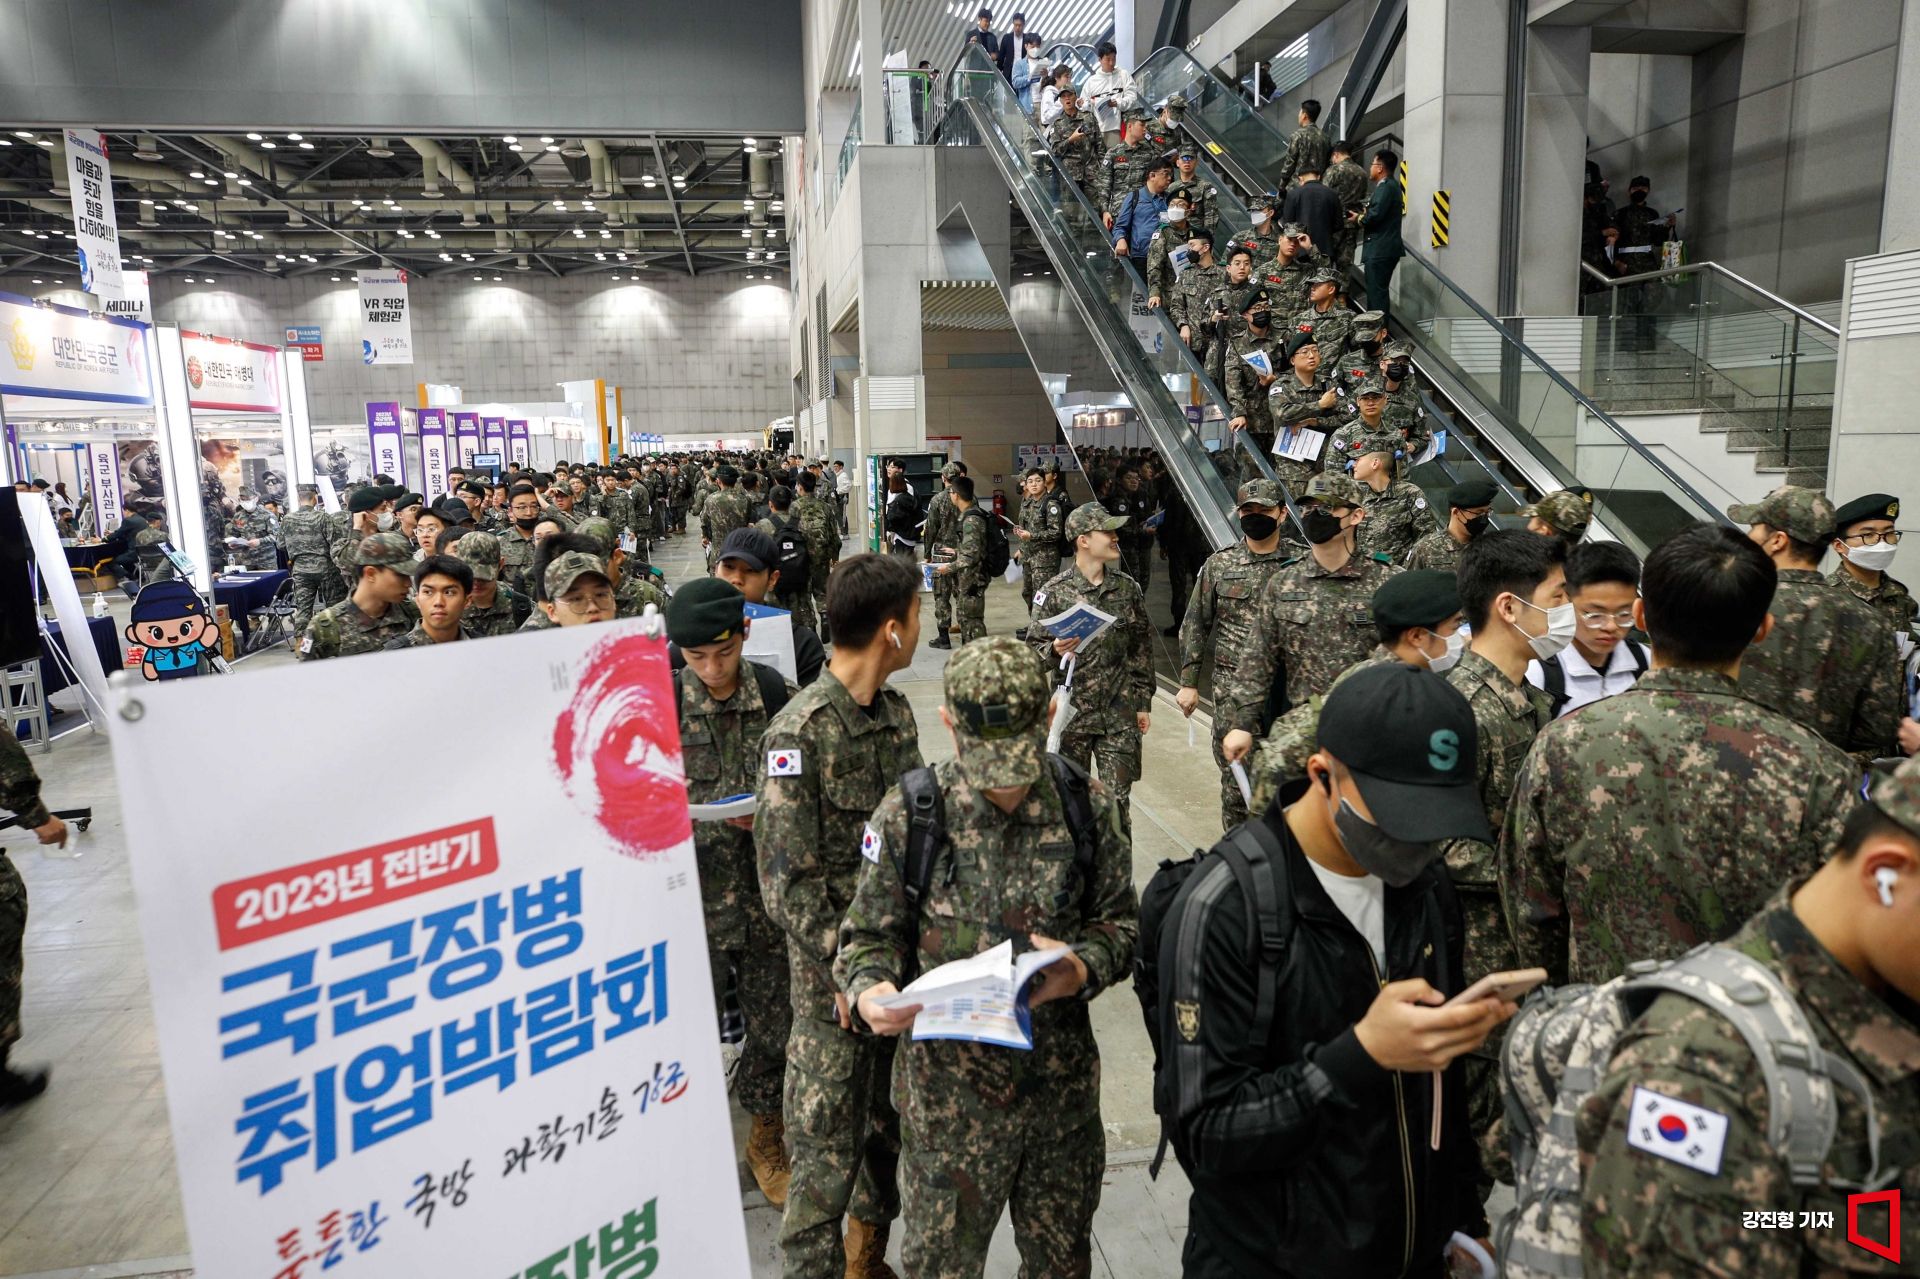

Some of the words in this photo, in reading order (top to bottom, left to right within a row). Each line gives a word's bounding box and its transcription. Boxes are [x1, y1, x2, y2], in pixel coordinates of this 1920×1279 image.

[76, 156, 103, 182] 마음과
[83, 179, 101, 200] 뜻과
[85, 199, 103, 220] 힘을
[79, 216, 115, 242] 다하여!!!
[106, 300, 144, 312] 세미나
[363, 298, 380, 309] VR
[383, 298, 405, 309] 직업
[368, 310, 402, 323] 체험관
[97, 453, 111, 475] 육군
[382, 448, 395, 473] 육군
[429, 448, 441, 470] 육군
[101, 479, 114, 509] 부사관
[430, 474, 442, 495] 장교
[1427, 728, 1460, 772] S
[234, 866, 373, 931] 2023년
[380, 832, 483, 884] 전반기
[218, 867, 586, 1061] 국군장병
[235, 940, 670, 1197] 취업박람회
[404, 1157, 475, 1230] 국방
[502, 1085, 625, 1178] 과학기술
[632, 1060, 690, 1115] 강군
[508, 1195, 660, 1279] 장병
